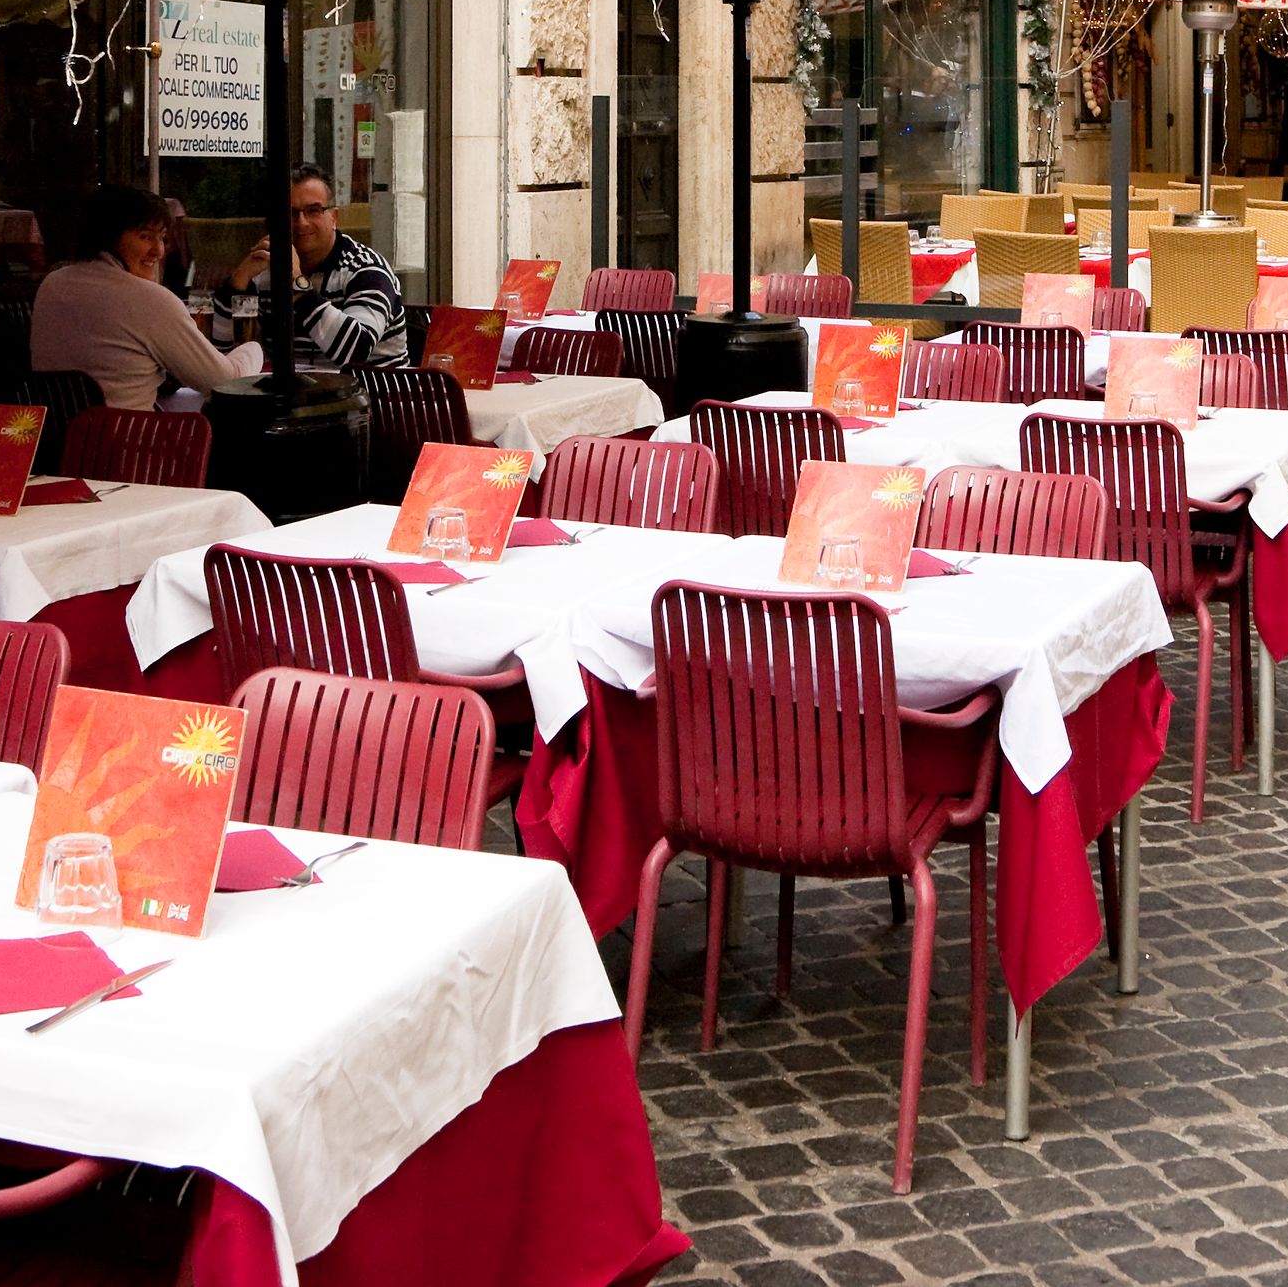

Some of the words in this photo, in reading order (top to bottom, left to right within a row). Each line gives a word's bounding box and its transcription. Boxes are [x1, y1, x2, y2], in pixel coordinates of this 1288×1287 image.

[192, 21, 218, 44] real
[222, 29, 261, 48] estate
[175, 53, 198, 72] PER
[201, 54, 211, 73] IL
[215, 56, 239, 74] TUO
[158, 77, 189, 97] OCALE
[191, 80, 261, 101] COMMERCIALE
[162, 106, 249, 131] 06/996986
[158, 134, 263, 154] ww.rzrealestate.com
[161, 746, 195, 764] CIRO
[196, 754, 203, 765] &
[204, 753, 237, 770] CIRO
